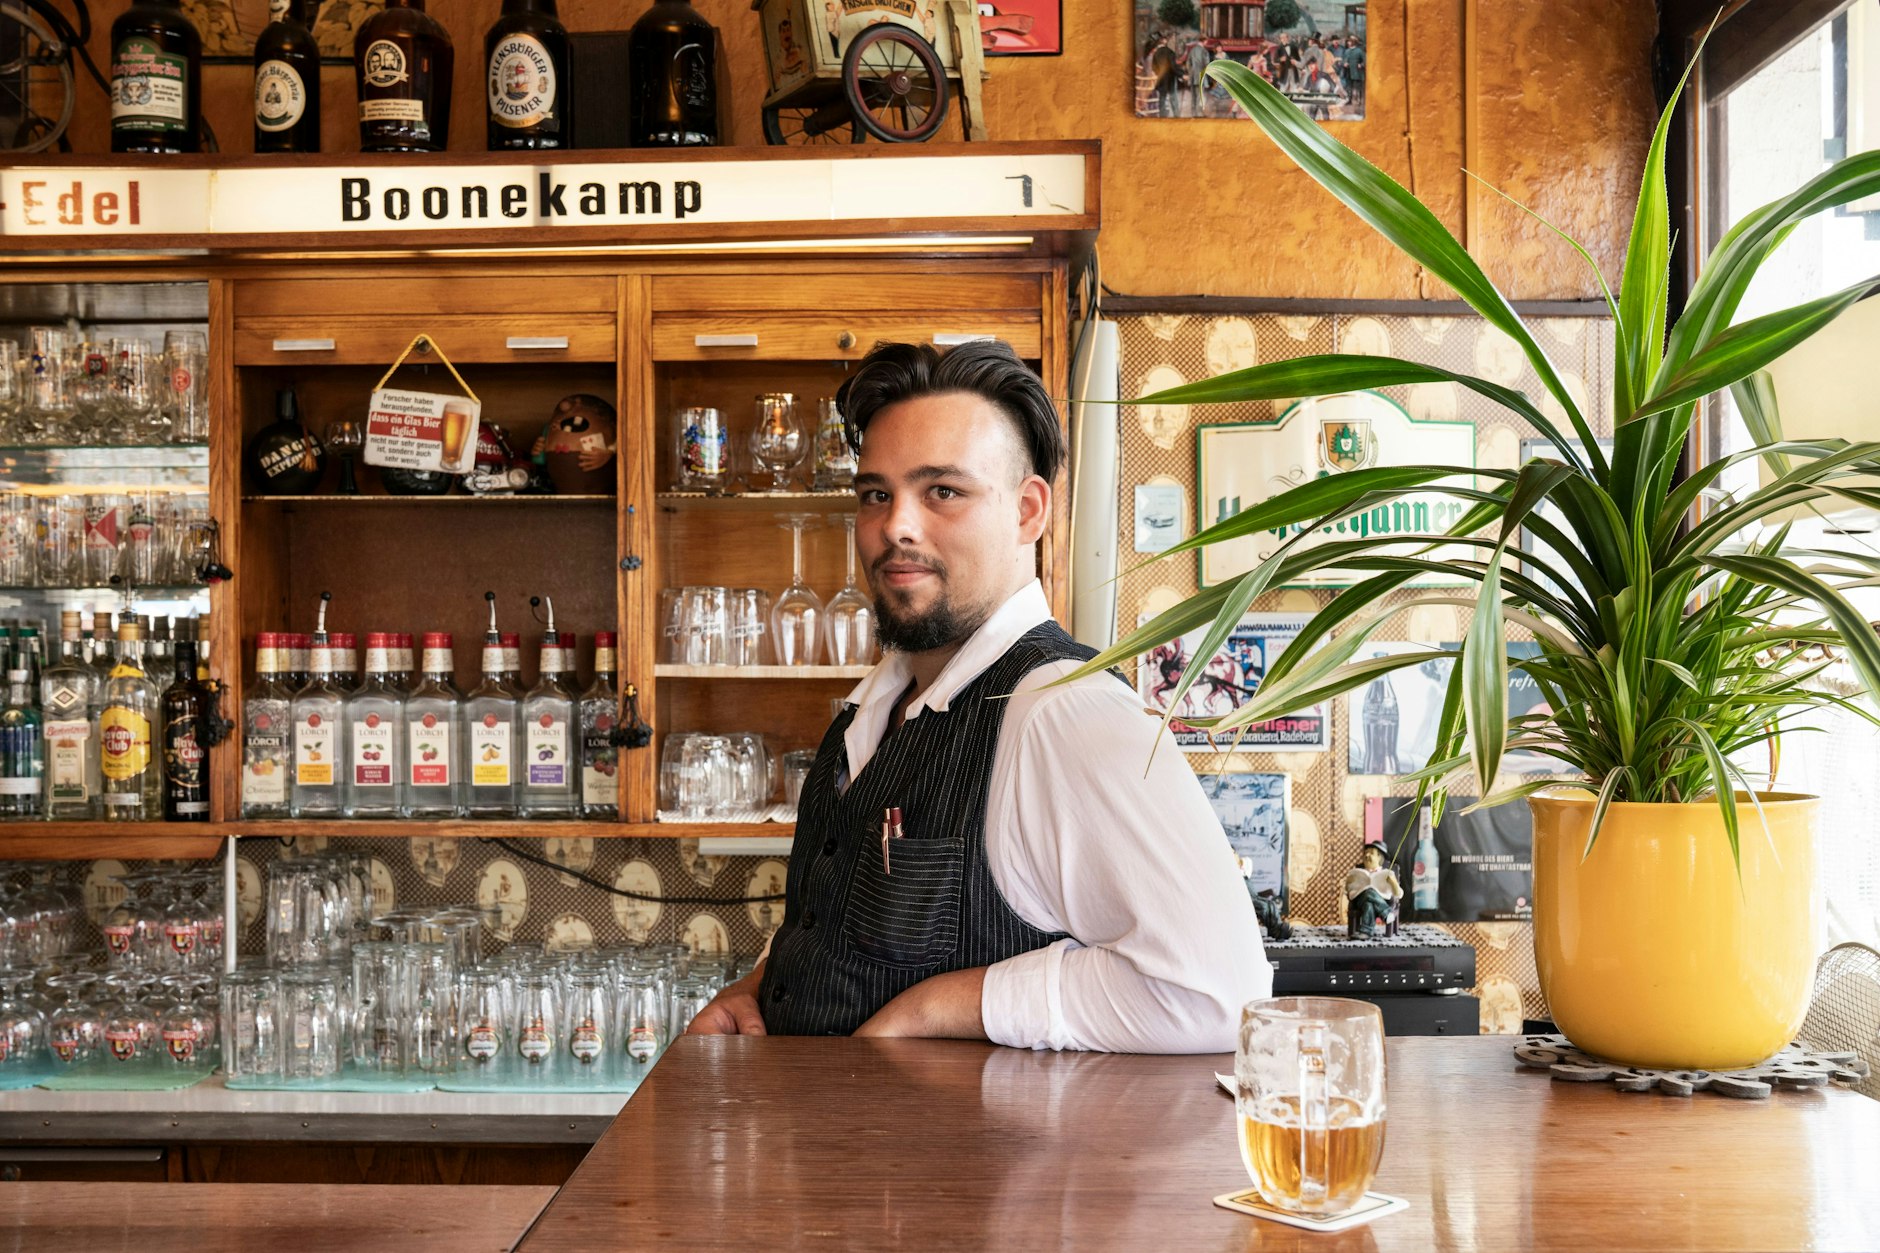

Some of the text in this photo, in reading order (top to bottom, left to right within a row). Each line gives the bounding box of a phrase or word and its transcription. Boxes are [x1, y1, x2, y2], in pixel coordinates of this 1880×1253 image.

[492, 43, 547, 76] FLENSBURGER
[496, 96, 542, 115] PILSENER
[341, 172, 702, 222] Boonekamp
[383, 393, 434, 405] Forscher haben
[381, 402, 434, 415] herausgefunden,
[371, 412, 441, 428] dass ein Glas Bier
[391, 426, 417, 437] täglich
[371, 436, 440, 451] nicht nur sehr gesund
[388, 446, 414, 455] sondern
[416, 449, 431, 457] auch
[1251, 719, 1319, 732] Pilsner
[248, 736, 280, 746] LÖRCH
[588, 737, 611, 747] LÖRC
[1280, 731, 1319, 743] Radeberg
[107, 740, 128, 750] Club
[181, 748, 204, 758] Club
[190, 769, 199, 780] 7
[1450, 854, 1514, 864] DIE WÜRDE DES BIERS
[1478, 863, 1489, 871] IST
